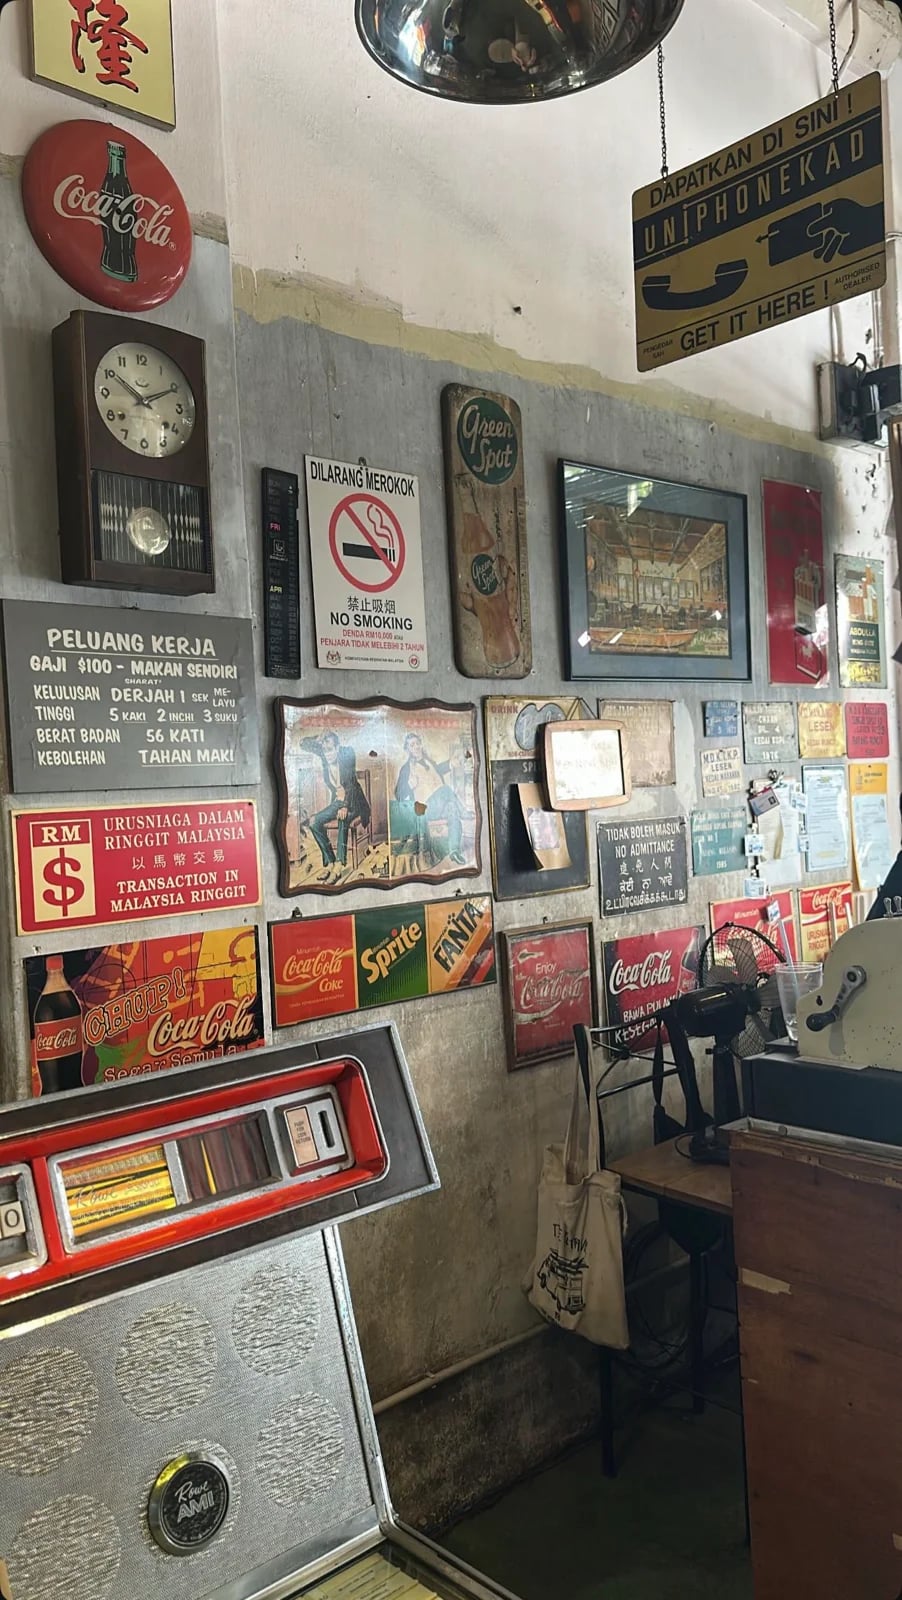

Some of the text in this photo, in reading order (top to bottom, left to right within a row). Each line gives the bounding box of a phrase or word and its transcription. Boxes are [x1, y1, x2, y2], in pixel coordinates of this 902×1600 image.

[650, 143, 751, 208] DAPATKAN
[763, 128, 783, 156] DI
[794, 100, 838, 139] SINI
[644, 129, 864, 252] UNIPHONEKAD
[53, 174, 174, 246] Coca-Cola
[835, 262, 880, 285] AUTHORISED
[843, 274, 873, 291] DEALER
[680, 320, 720, 351] GET
[730, 311, 747, 335] IT
[757, 284, 816, 324] HERE
[118, 356, 127, 367] 11
[136, 354, 148, 366] 12
[104, 369, 116, 379] 10
[106, 410, 115, 421] 8
[175, 404, 183, 415] 3
[120, 429, 128, 440] 7
[171, 423, 180, 434] 4
[462, 404, 514, 454] Green
[140, 438, 149, 449] 6
[472, 439, 513, 477] Spot
[310, 461, 415, 498] DILARANG MEROKOK
[270, 523, 281, 532] FRI
[269, 585, 283, 594] APR
[347, 595, 396, 615] 禁止吸烟
[330, 612, 413, 631] NO SMOKING
[47, 628, 216, 657] PELUANG KERJA
[342, 629, 365, 639] DENDA
[320, 637, 350, 648] PENJARA
[351, 639, 370, 649] TIDAK
[405, 642, 425, 652] TAHUN
[30, 655, 67, 673] GAJI
[78, 656, 112, 675] $100
[131, 660, 182, 677] MAKAN
[186, 662, 238, 680] SENDIRI
[33, 685, 209, 704] KELULUSAN DERJAH 1 SEK
[212, 698, 236, 709] LAYU
[35, 706, 238, 723] TINGGI 5 KAKI 2 INCHI 3 SUKU
[36, 728, 205, 744] BERAT BADAN 56 KATI
[37, 749, 235, 766] KEBOLEHAN TAHAN MAKI
[103, 809, 245, 832] URUSNIAGA DALAM
[41, 824, 82, 844] RM
[104, 826, 246, 850] RINGGIT MALAYSIA
[606, 822, 681, 843] TIDAK BOLEH MASUK
[615, 840, 675, 859] NO ADMITTANCE
[116, 869, 239, 895] TRANSACTION IN
[110, 884, 247, 913] MALAYSIA RINGGIT
[360, 922, 423, 984] Sprite
[283, 947, 344, 983] Coca-Cola
[535, 962, 557, 974] Enjoy
[609, 949, 672, 995] Coca-Cola
[319, 977, 344, 993] Coke
[83, 967, 186, 1047] CHUP!
[623, 1007, 646, 1023] BAWA
[147, 995, 255, 1057] Coca-Cola
[36, 1028, 77, 1052] Coca-Cola
[170, 1045, 238, 1069] Semula
[174, 1479, 210, 1504] Rowe
[176, 1499, 215, 1521] AMI
